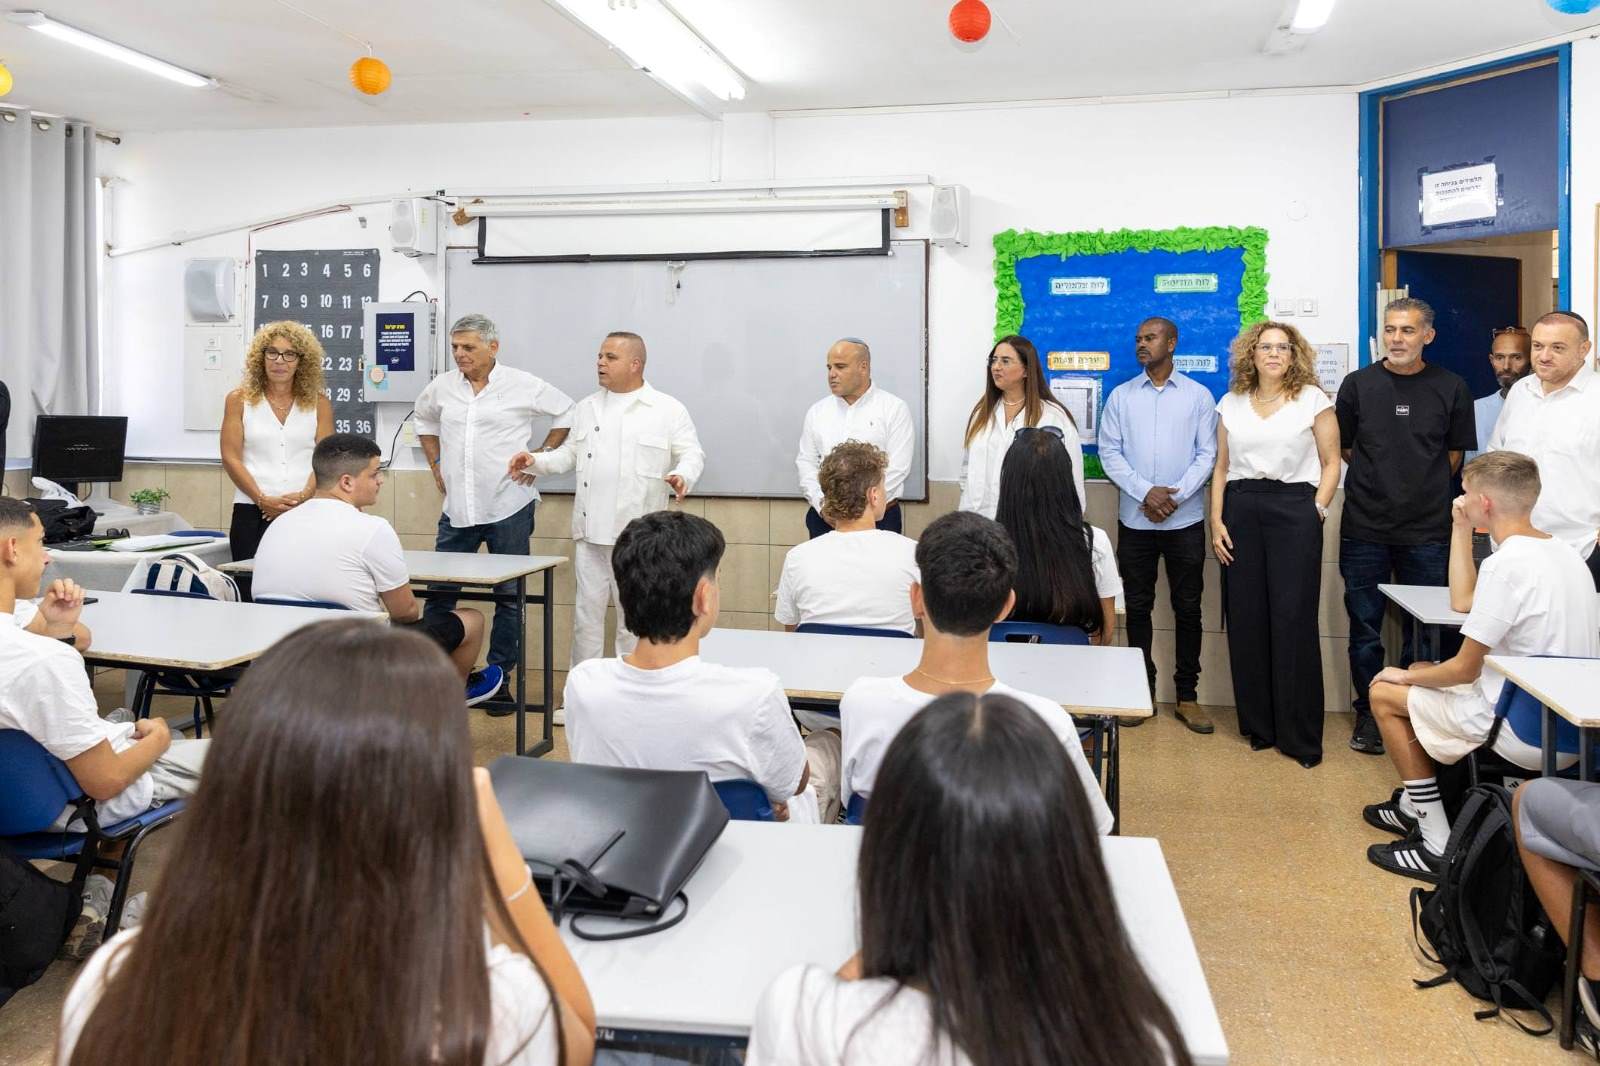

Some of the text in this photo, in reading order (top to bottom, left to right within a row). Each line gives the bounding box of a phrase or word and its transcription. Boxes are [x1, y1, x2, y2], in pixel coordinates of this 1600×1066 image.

[262, 262, 371, 278] 1 2 3 4 5 6
[262, 295, 269, 308] 7
[282, 294, 290, 308] 8
[300, 294, 308, 308] 9
[320, 294, 332, 308] 10
[342, 295, 351, 309] 11
[321, 324, 334, 338] 16
[341, 325, 352, 339] 17
[339, 357, 352, 371] 23
[336, 388, 350, 402] 29
[336, 420, 371, 433] 35 36
